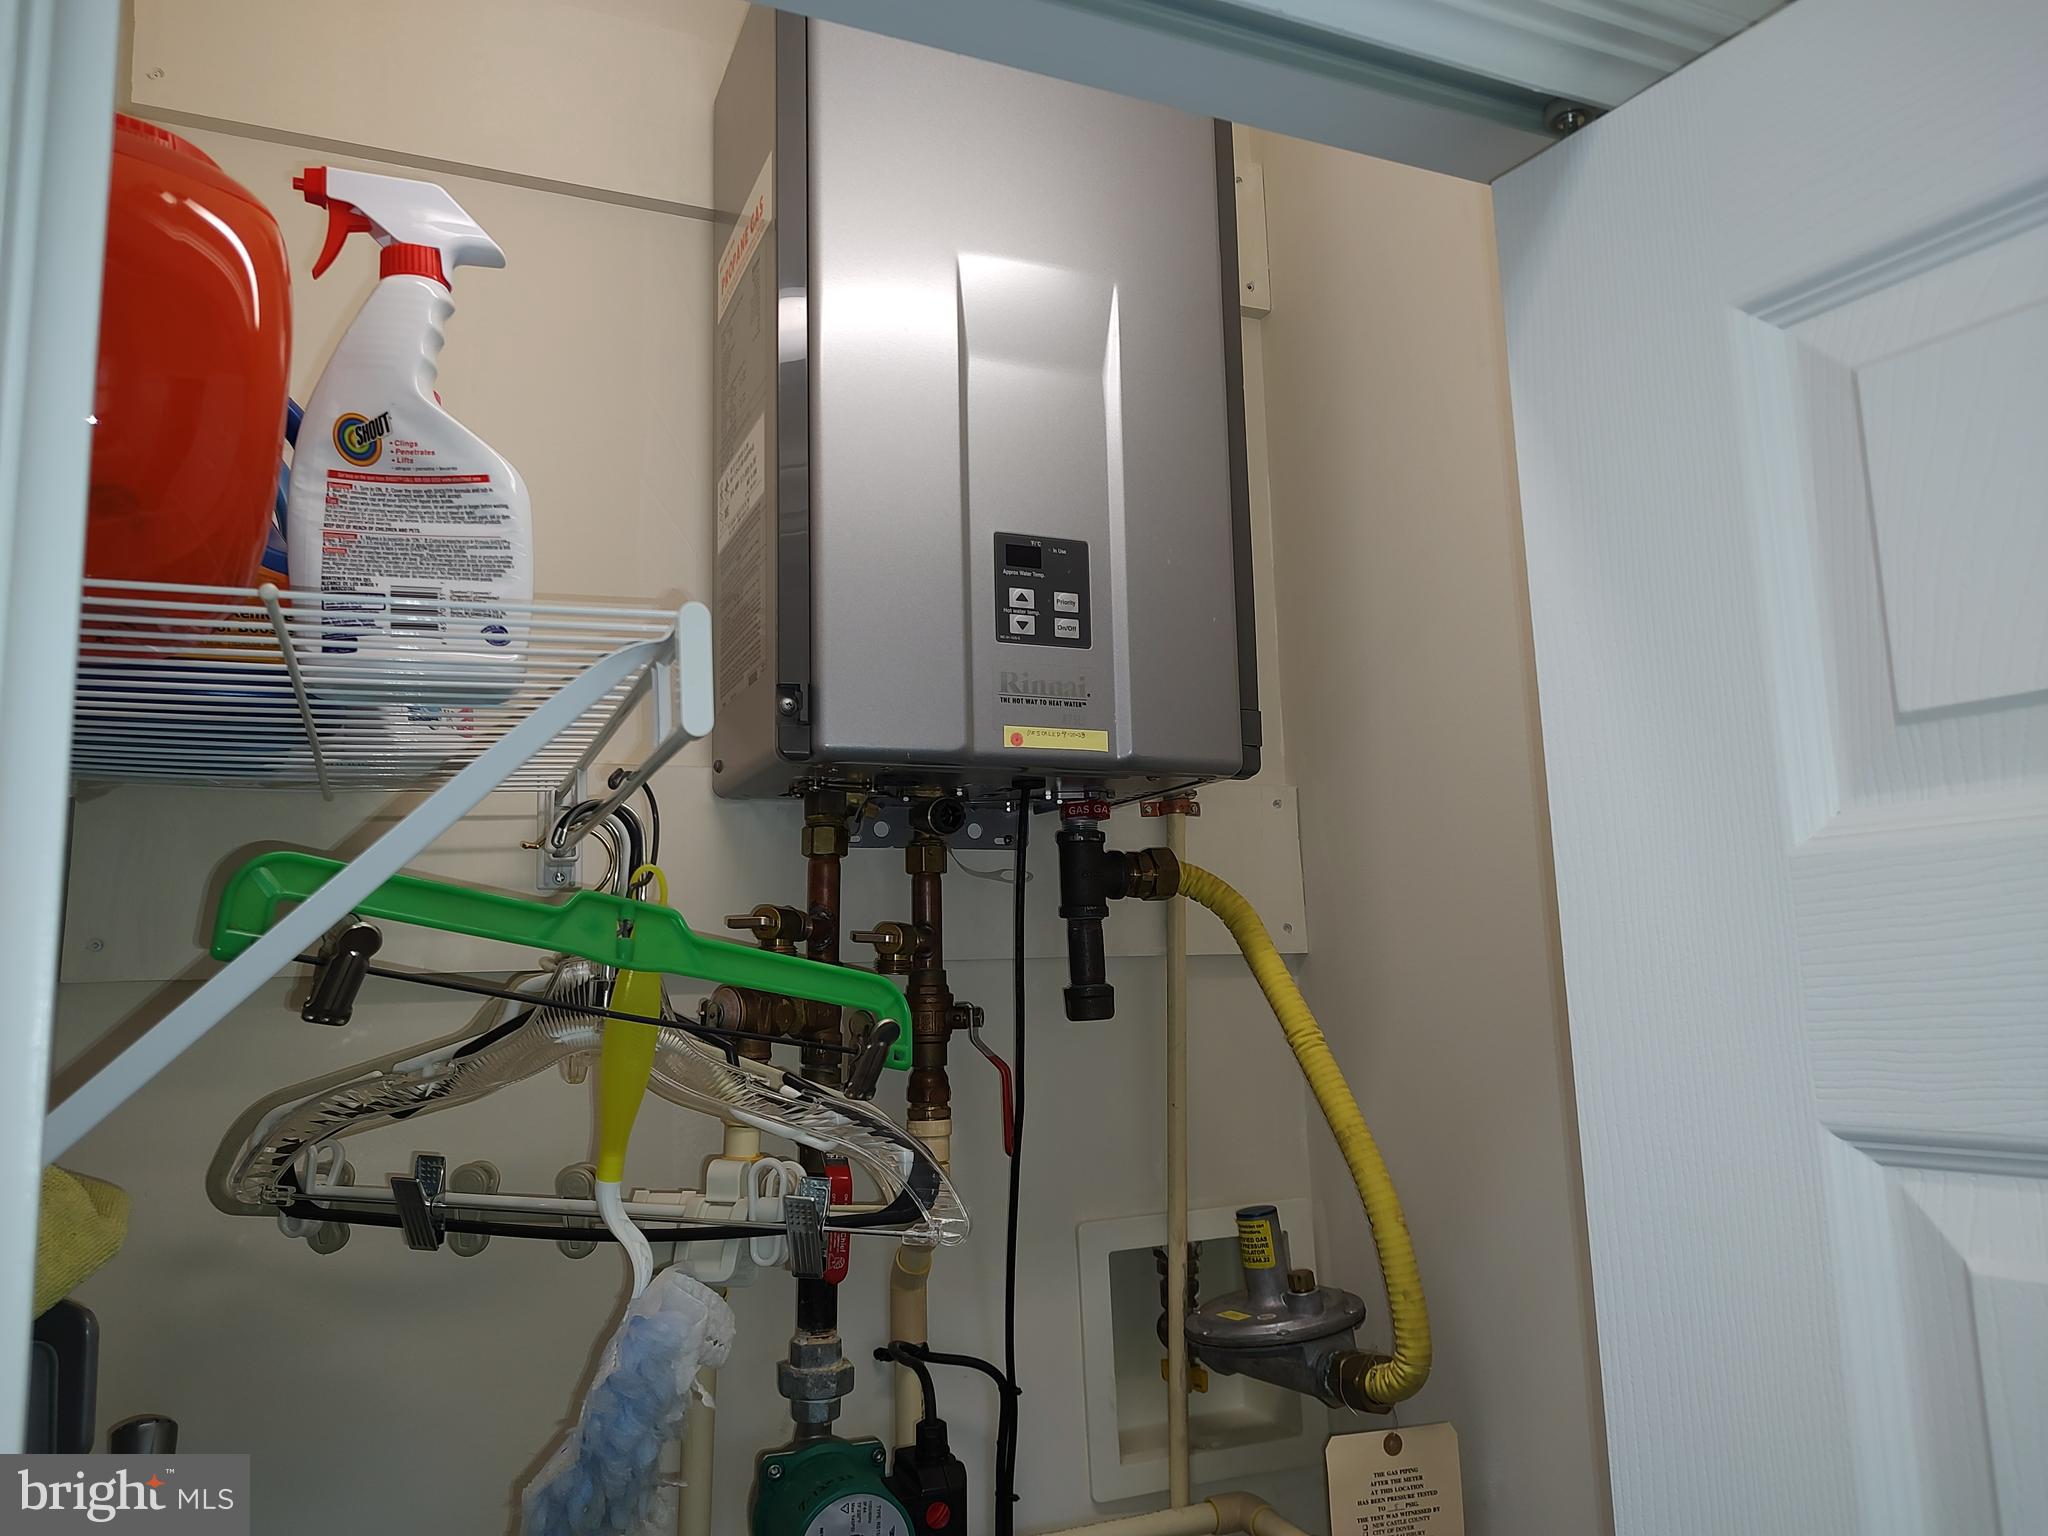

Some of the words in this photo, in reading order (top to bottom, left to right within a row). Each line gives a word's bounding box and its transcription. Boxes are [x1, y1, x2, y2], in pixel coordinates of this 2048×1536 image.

[354, 411, 391, 447] SHOUT
[394, 440, 418, 448] Clings
[395, 448, 435, 456] Penetrates
[1056, 599, 1076, 608] Priority
[1057, 624, 1077, 632] On/Off
[999, 672, 1087, 699] Rinnai
[1068, 805, 1090, 815] GAS
[1094, 804, 1110, 814] GA
[1399, 1467, 1419, 1475] PIPING
[1370, 1479, 1388, 1487] AFTER
[1403, 1475, 1423, 1483] METER
[1380, 1487, 1393, 1495] THIS
[1394, 1483, 1424, 1492] LOCATION
[1370, 1497, 1386, 1505] BEEN
[1387, 1493, 1415, 1502] PRESSURE
[1416, 1490, 1438, 1498] TESTED
[1357, 1516, 1369, 1524] THE
[1370, 1514, 1384, 1522] TEST
[1399, 1508, 1432, 1517] WITNESSED
[1386, 1518, 1407, 1527] CASTLE
[1408, 1515, 1430, 1523] COUNTY
[1372, 1528, 1385, 1536] CITY
[1395, 1524, 1415, 1532] DOVER
